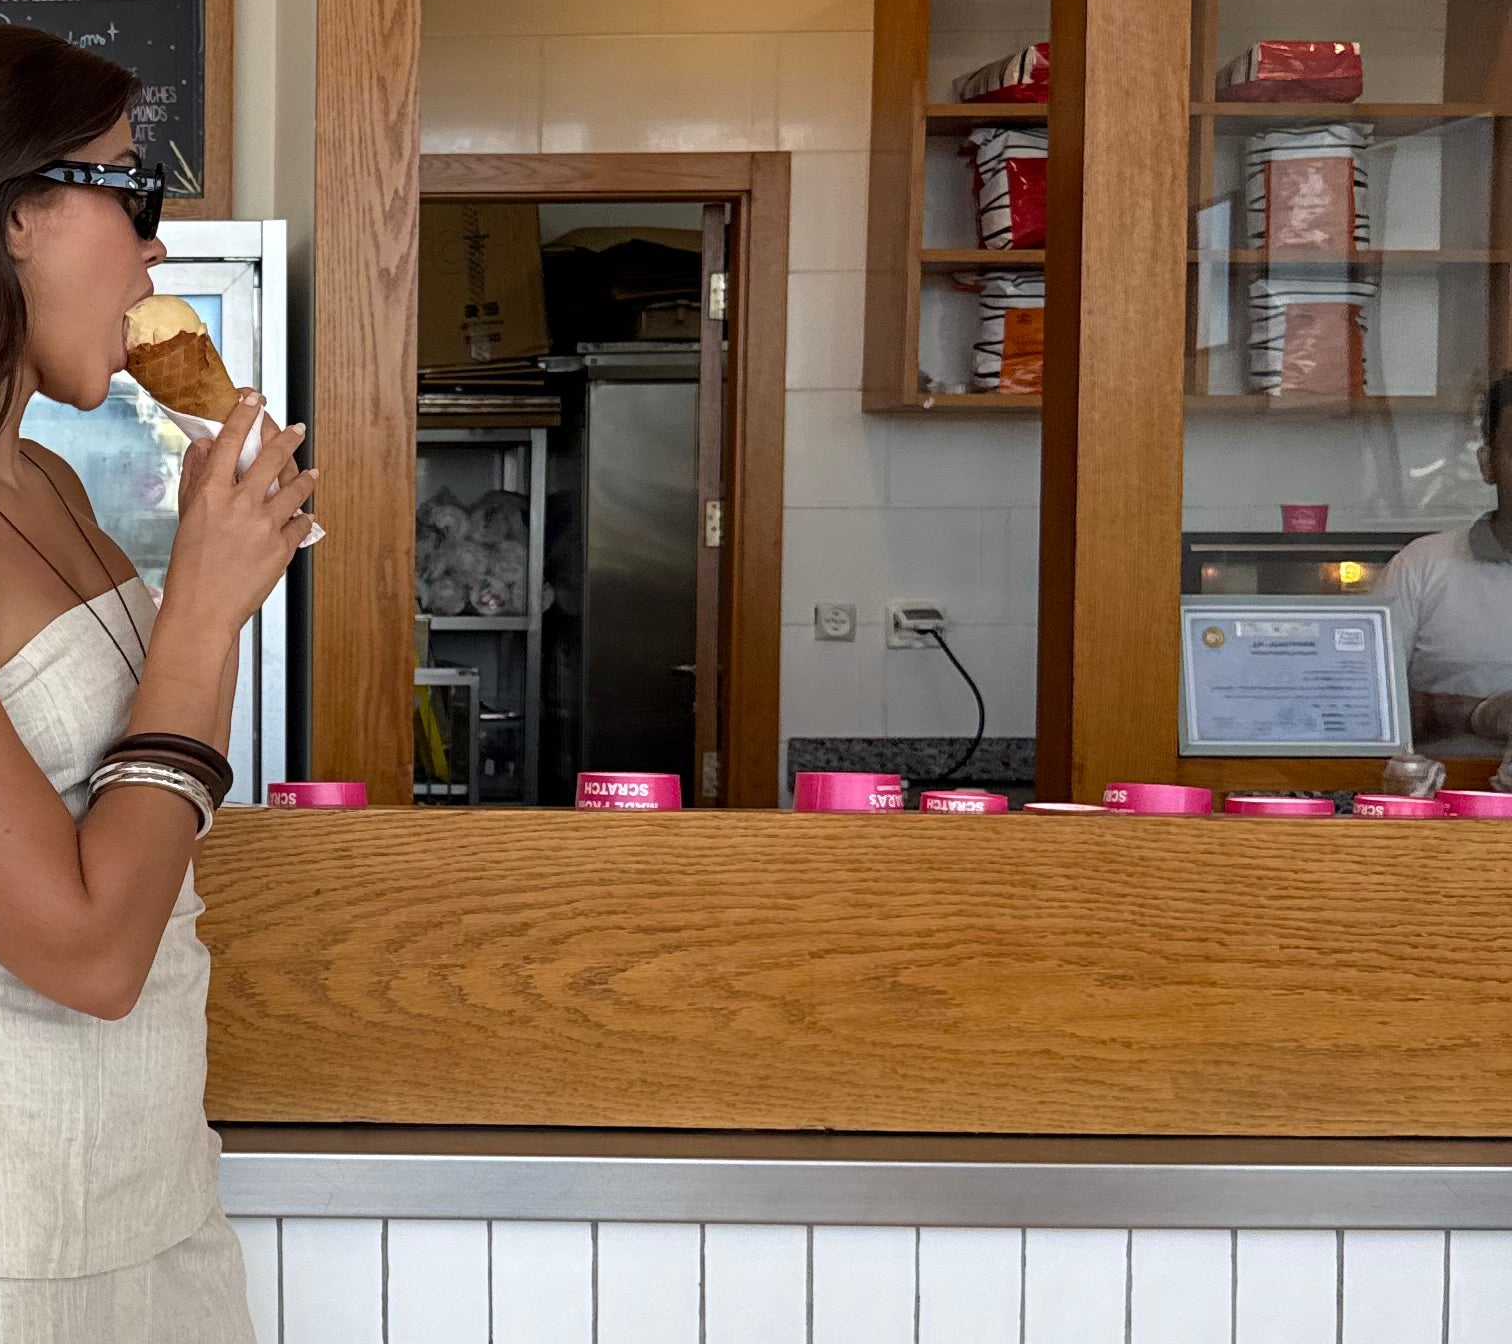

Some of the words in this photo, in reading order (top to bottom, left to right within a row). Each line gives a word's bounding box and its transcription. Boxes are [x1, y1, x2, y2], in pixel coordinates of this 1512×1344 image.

[140, 86, 178, 104] NCHES
[130, 104, 169, 123] MONDS
[584, 781, 649, 797] SCRATCH
[266, 791, 297, 806] SCRA
[868, 793, 904, 809] ARA's
[927, 798, 985, 814] SCRATCH
